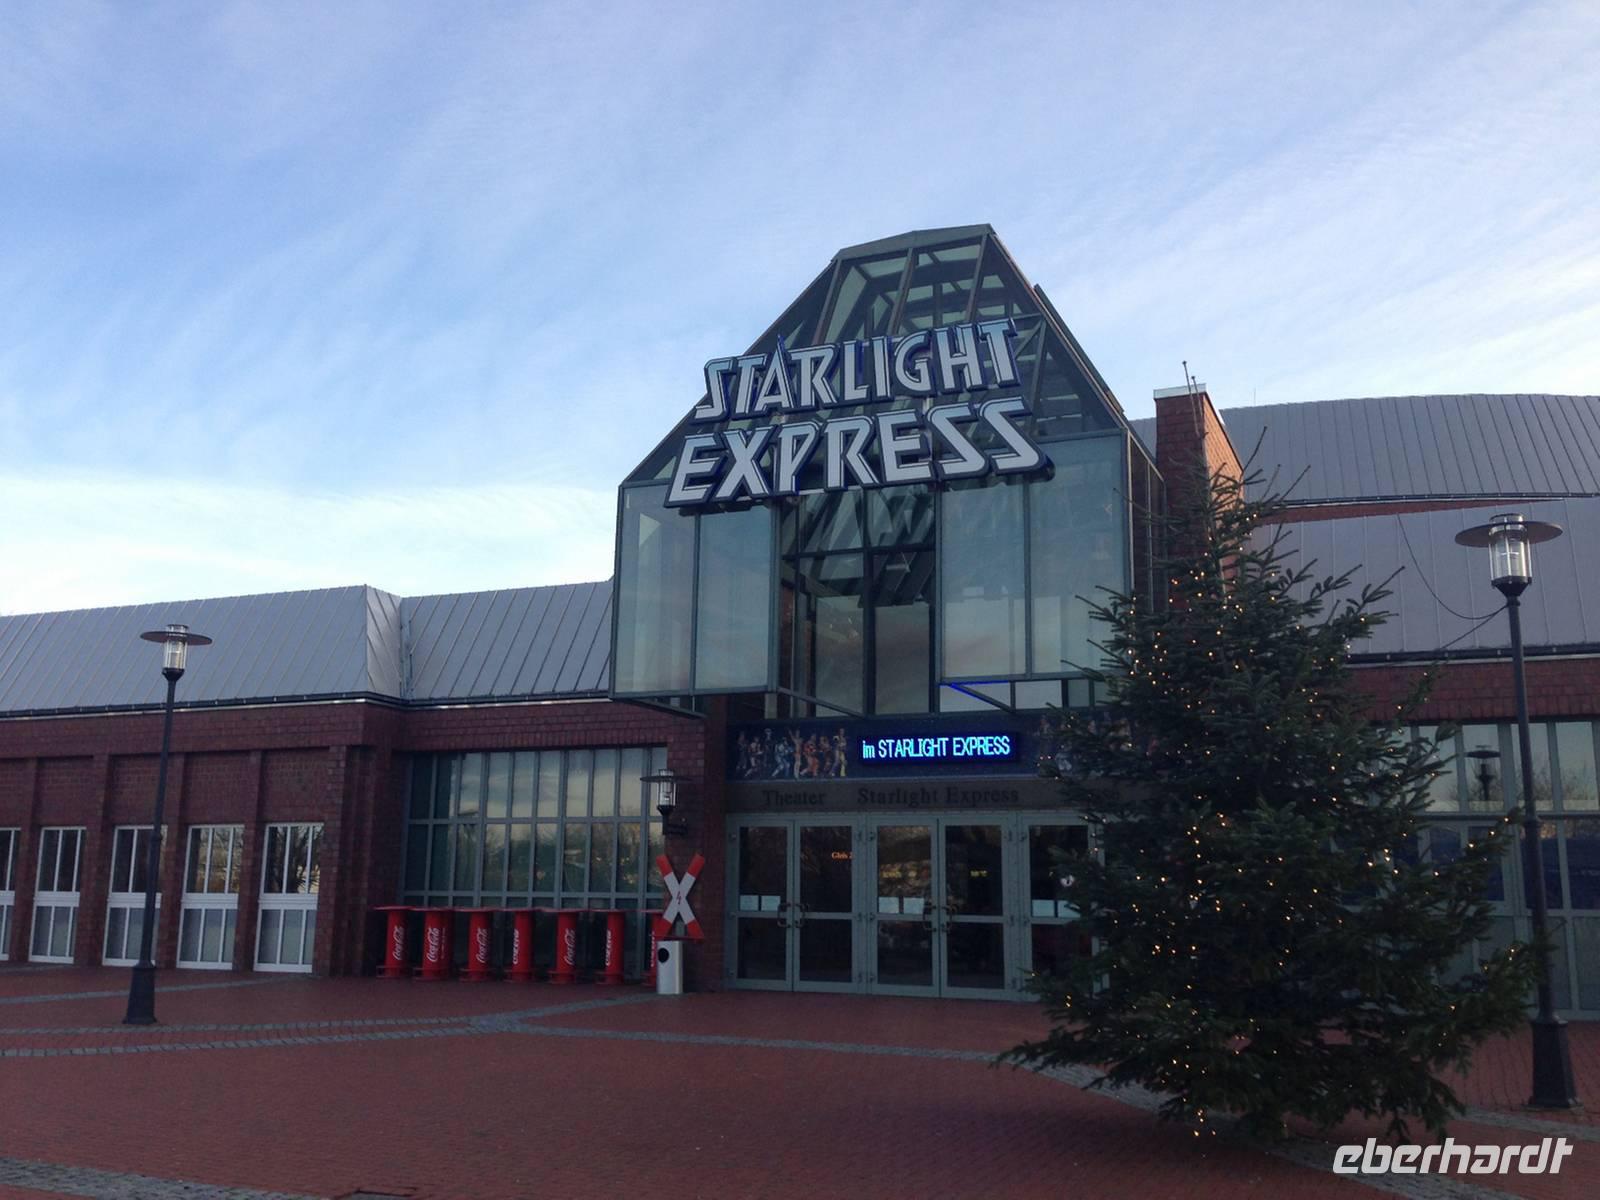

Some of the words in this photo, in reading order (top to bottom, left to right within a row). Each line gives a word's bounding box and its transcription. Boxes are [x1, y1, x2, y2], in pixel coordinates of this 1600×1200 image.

[693, 317, 1021, 421] STARLIGHT
[666, 396, 1044, 506] EXPRESS
[862, 740, 876, 759] im
[878, 737, 949, 758] STARLIGHT
[952, 735, 1011, 757] EXPRESS
[761, 788, 827, 806] Theater
[857, 786, 938, 809] Starlight
[945, 786, 1020, 808] Express
